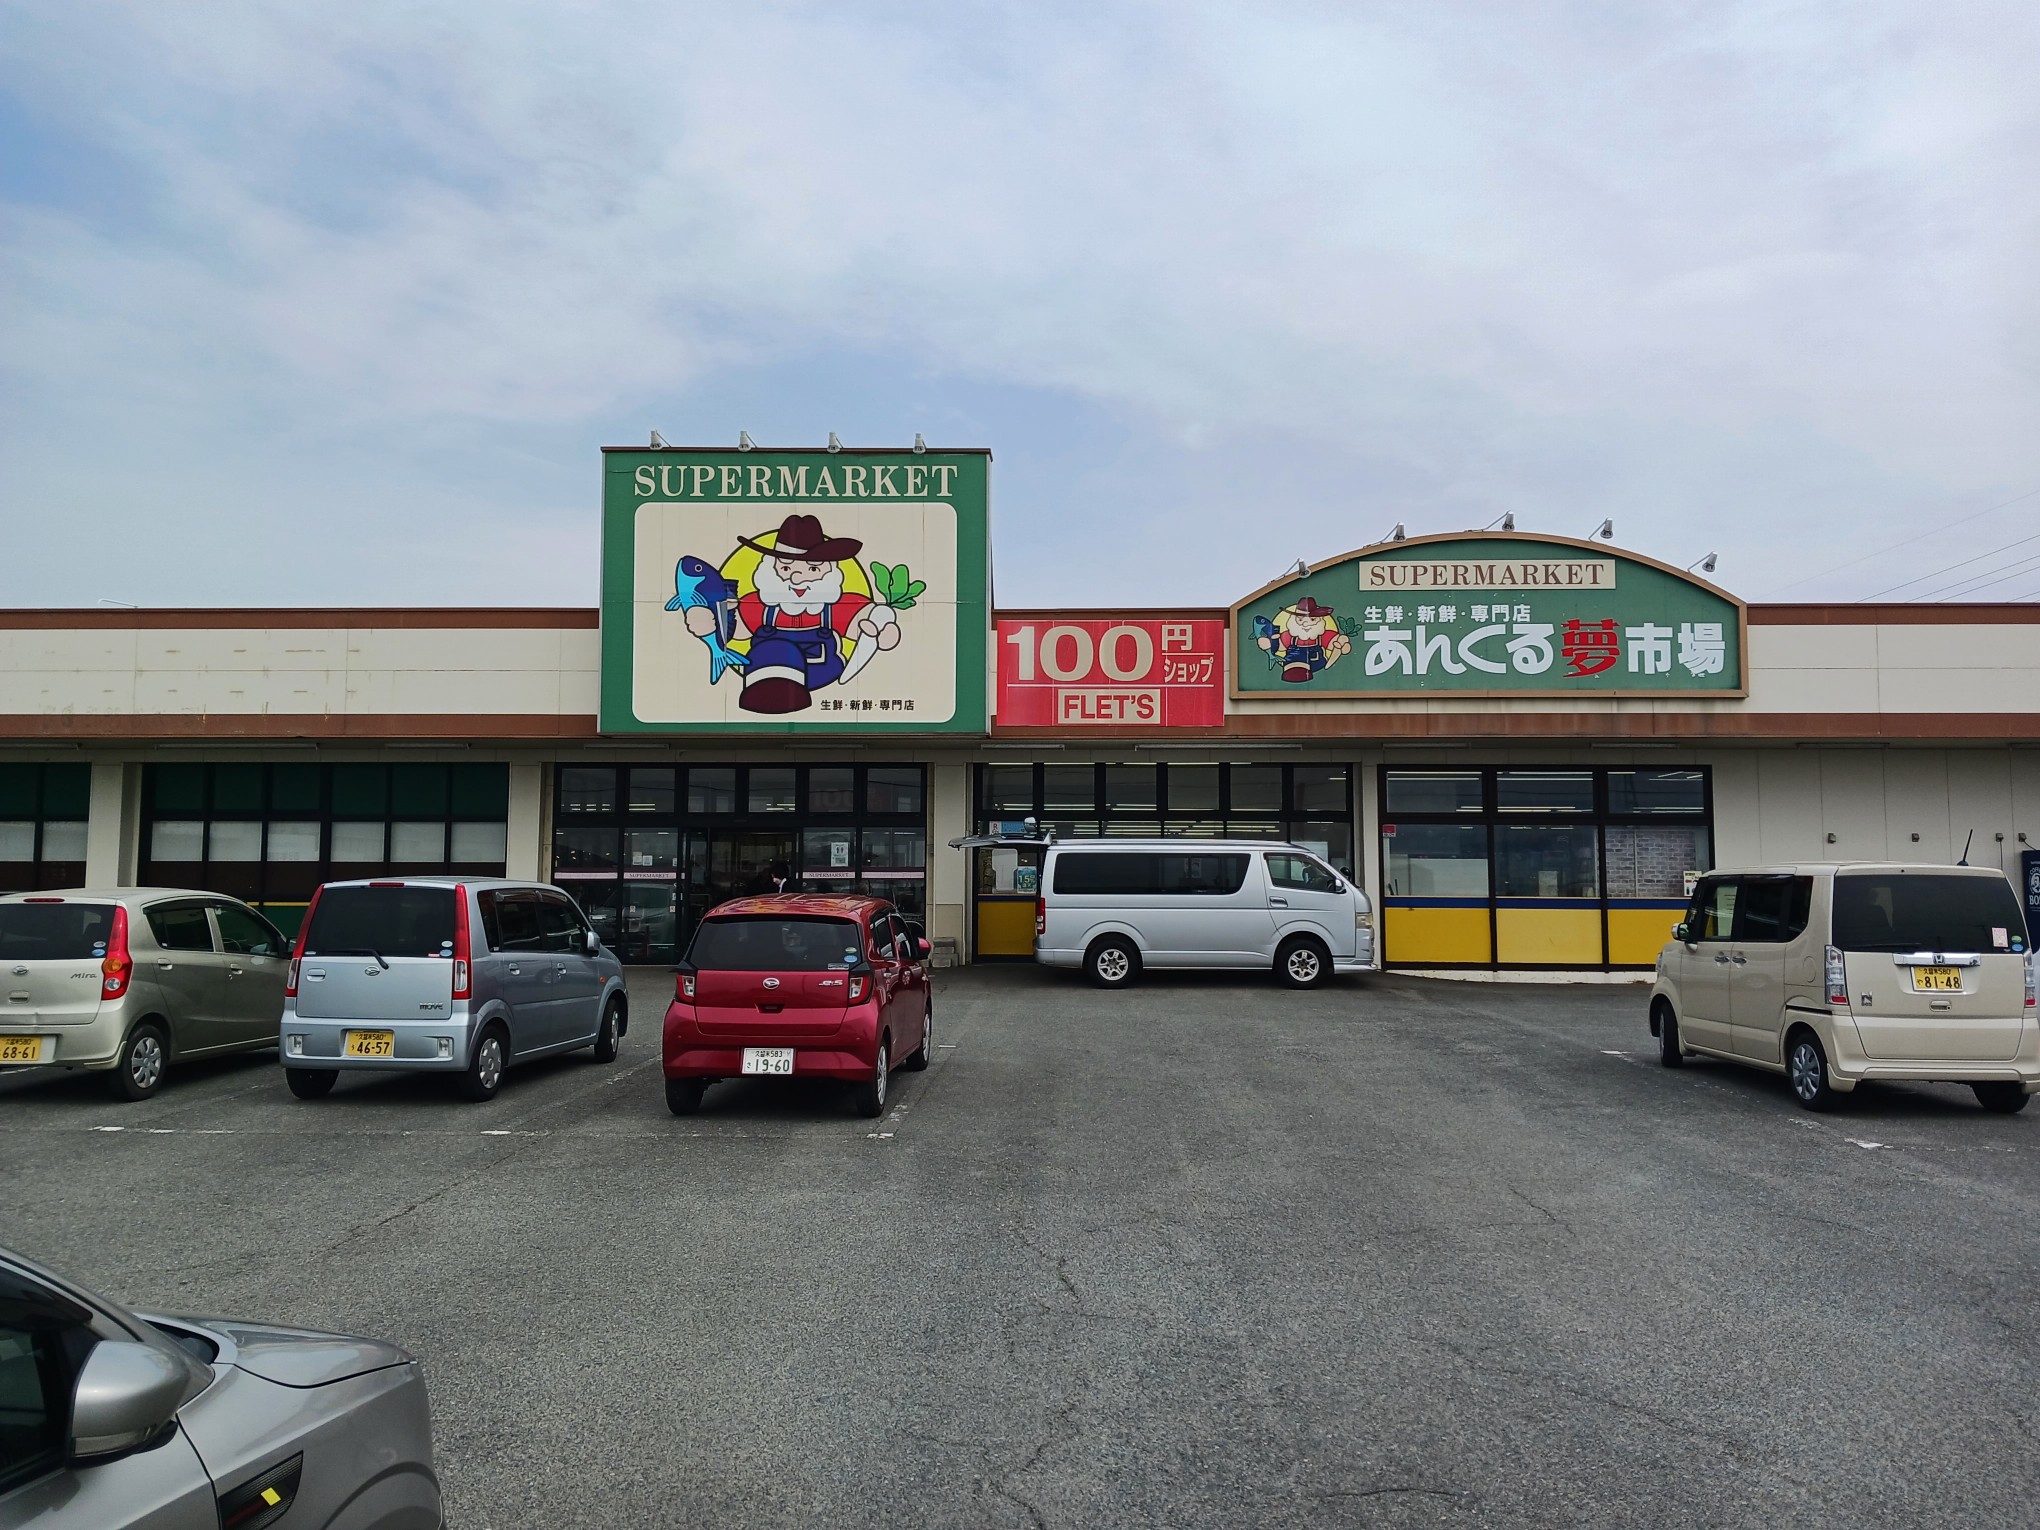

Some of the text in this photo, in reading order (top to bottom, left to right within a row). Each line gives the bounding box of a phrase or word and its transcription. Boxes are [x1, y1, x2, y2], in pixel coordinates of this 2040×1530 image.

[634, 464, 958, 497] SUPERMARKET
[1370, 564, 1604, 586] SUPERMARKET
[1163, 657, 1214, 683] ショップ
[1064, 694, 1154, 719] FLET'S
[1924, 976, 1960, 989] 81-48
[2, 1046, 36, 1059] 68-61
[357, 1041, 390, 1054] 46-57
[755, 1059, 790, 1072] 19-60
